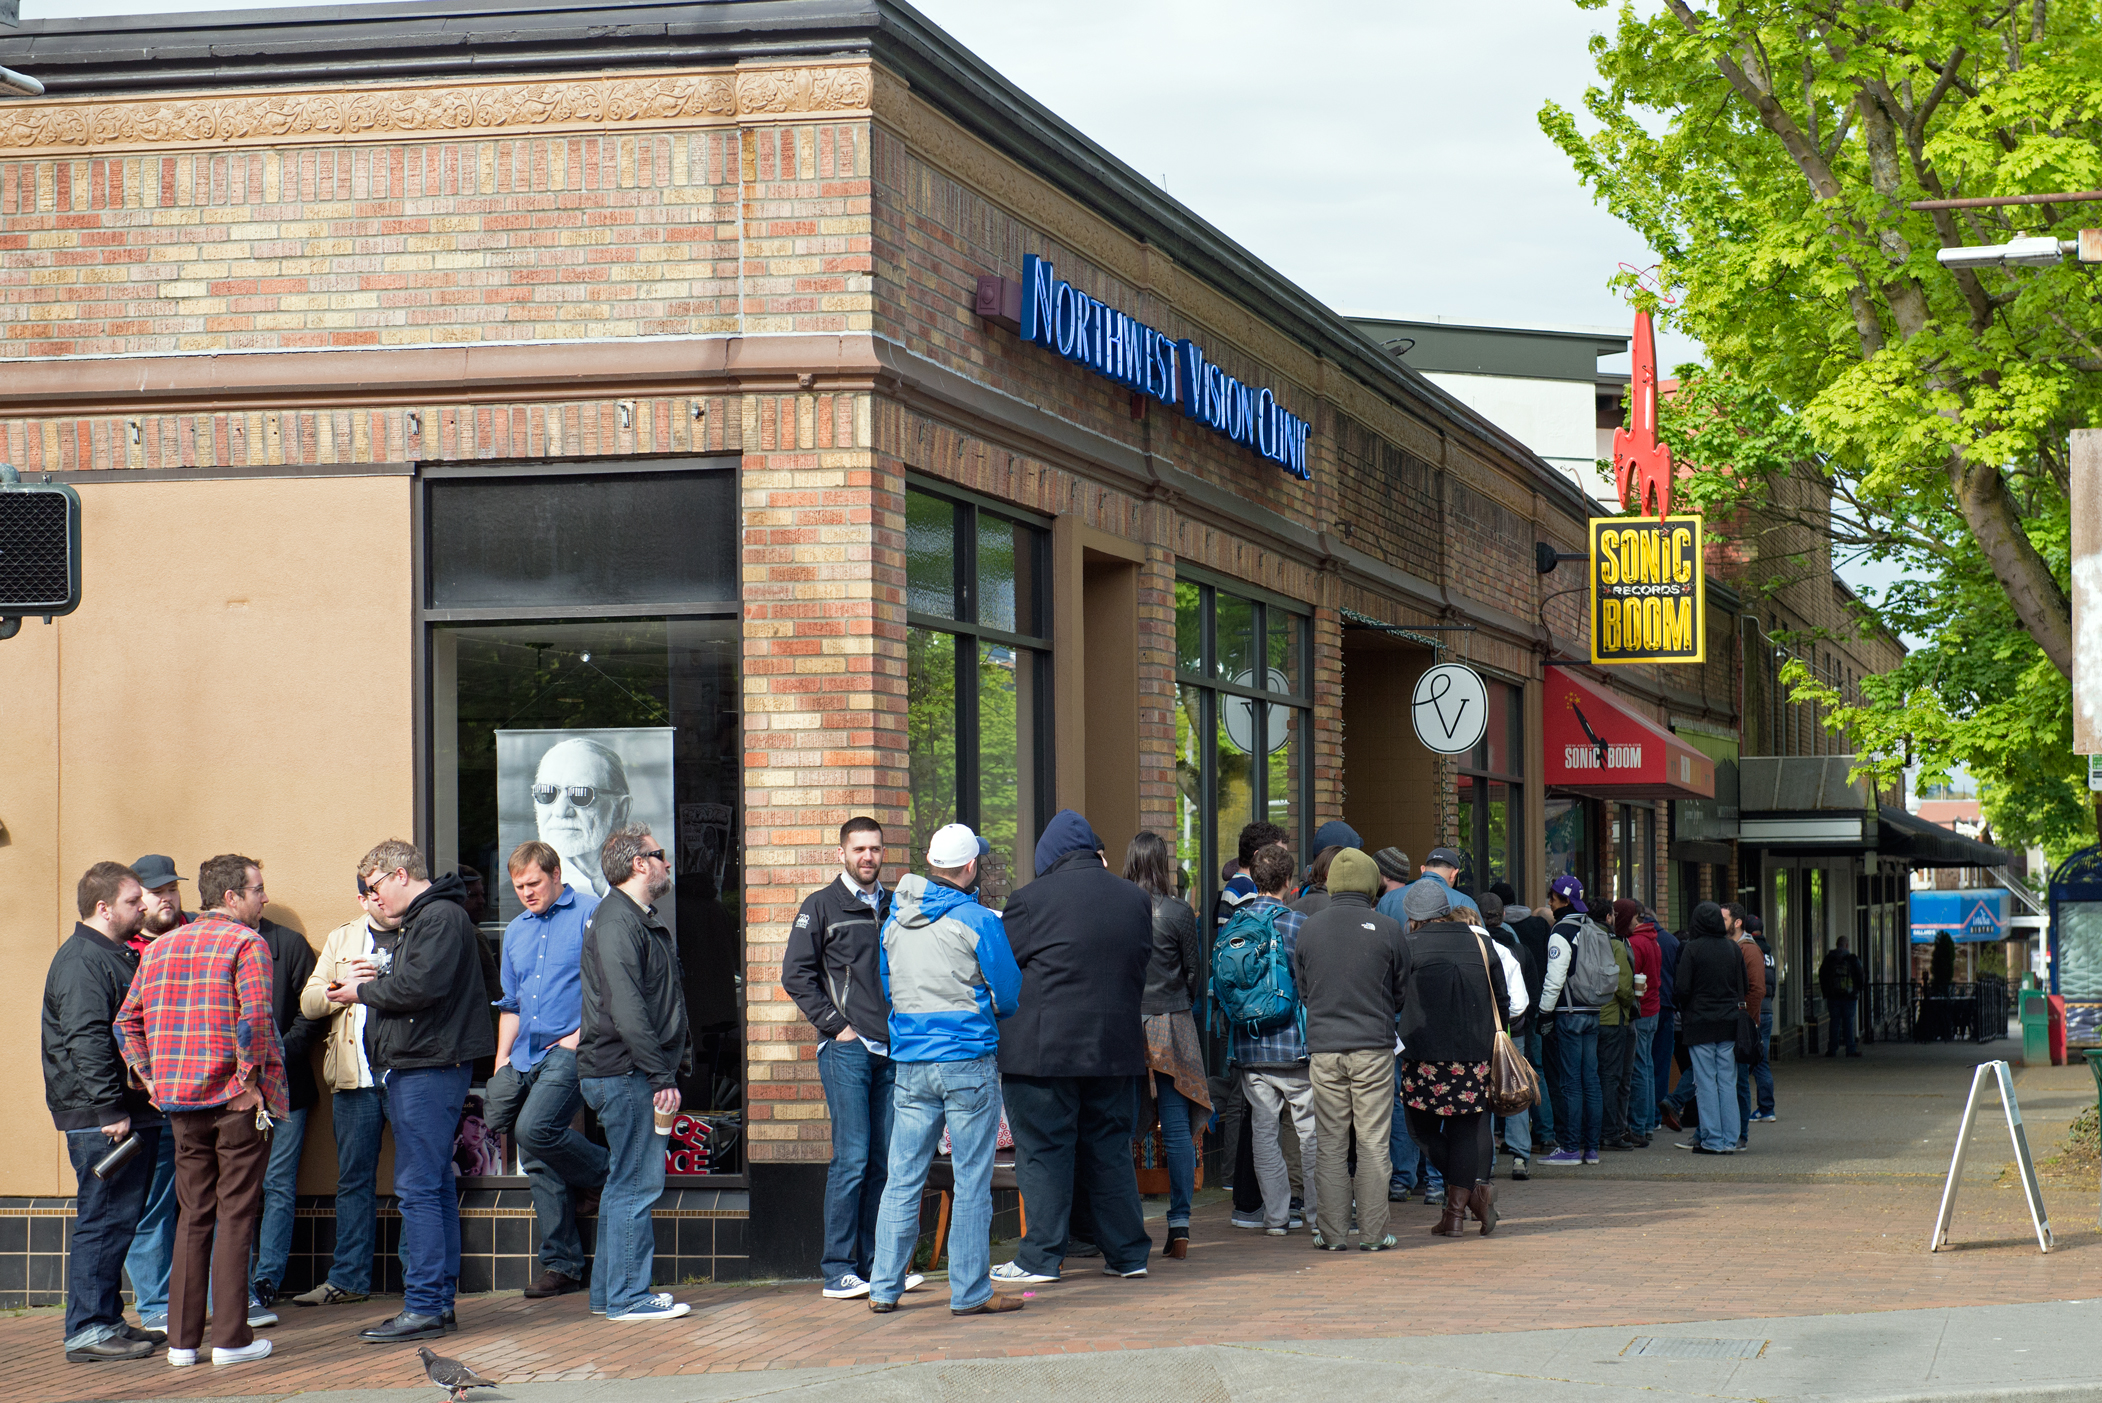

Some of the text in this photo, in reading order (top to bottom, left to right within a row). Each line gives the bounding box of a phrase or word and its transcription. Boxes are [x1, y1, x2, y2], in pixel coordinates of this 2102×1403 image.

[1020, 254, 1312, 481] NORTHWEST VISION CLINIC
[1612, 585, 1681, 595] RECORDS
[1602, 596, 1692, 652] BOOM
[1608, 747, 1641, 768] BOOM
